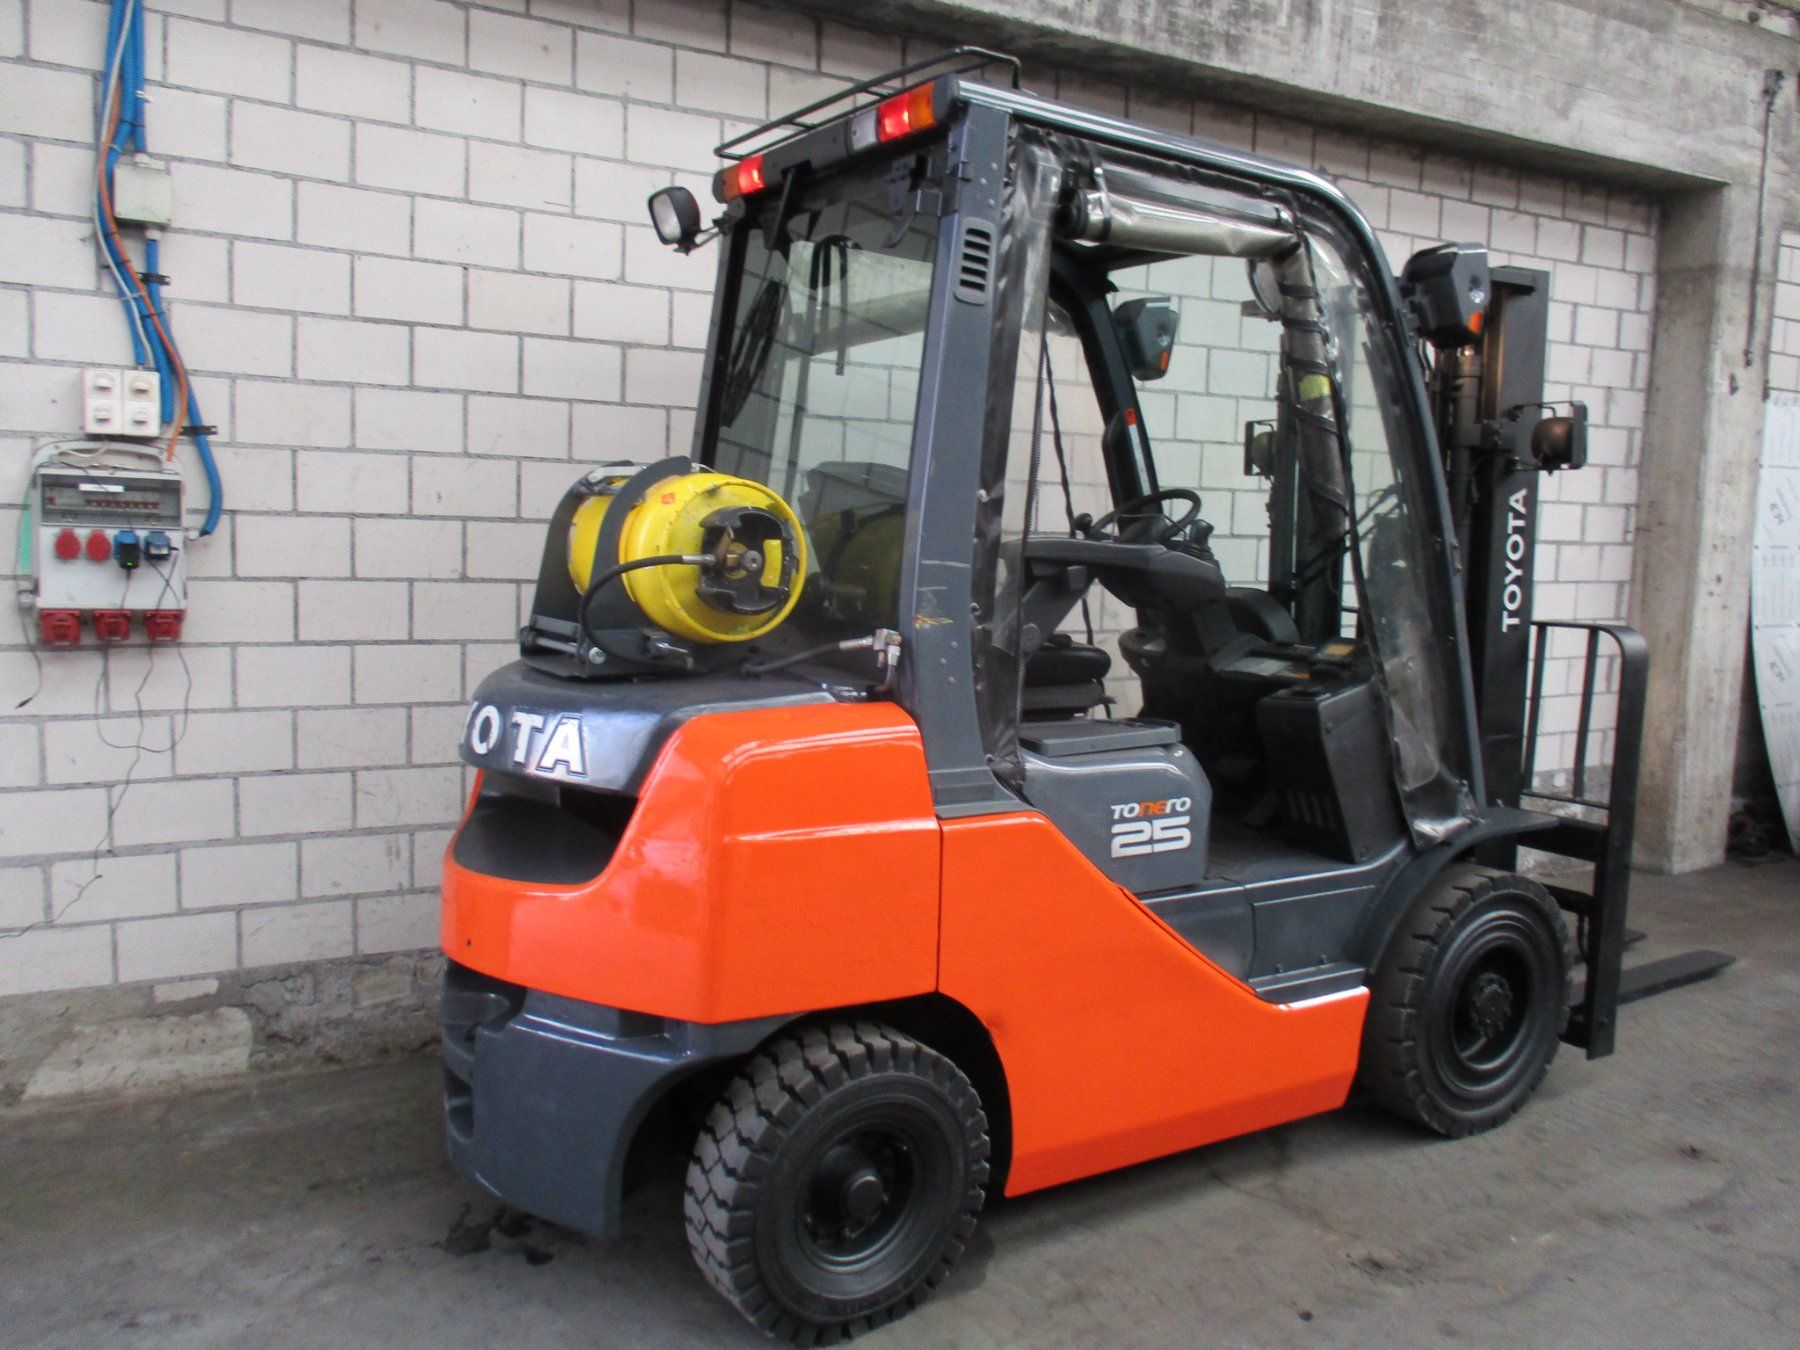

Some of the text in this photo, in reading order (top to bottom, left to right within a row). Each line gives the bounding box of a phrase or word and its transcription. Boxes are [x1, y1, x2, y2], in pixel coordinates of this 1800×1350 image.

[1502, 487, 1528, 633] TOYOTA
[461, 701, 588, 778] OTA
[1110, 815, 1192, 859] 25
